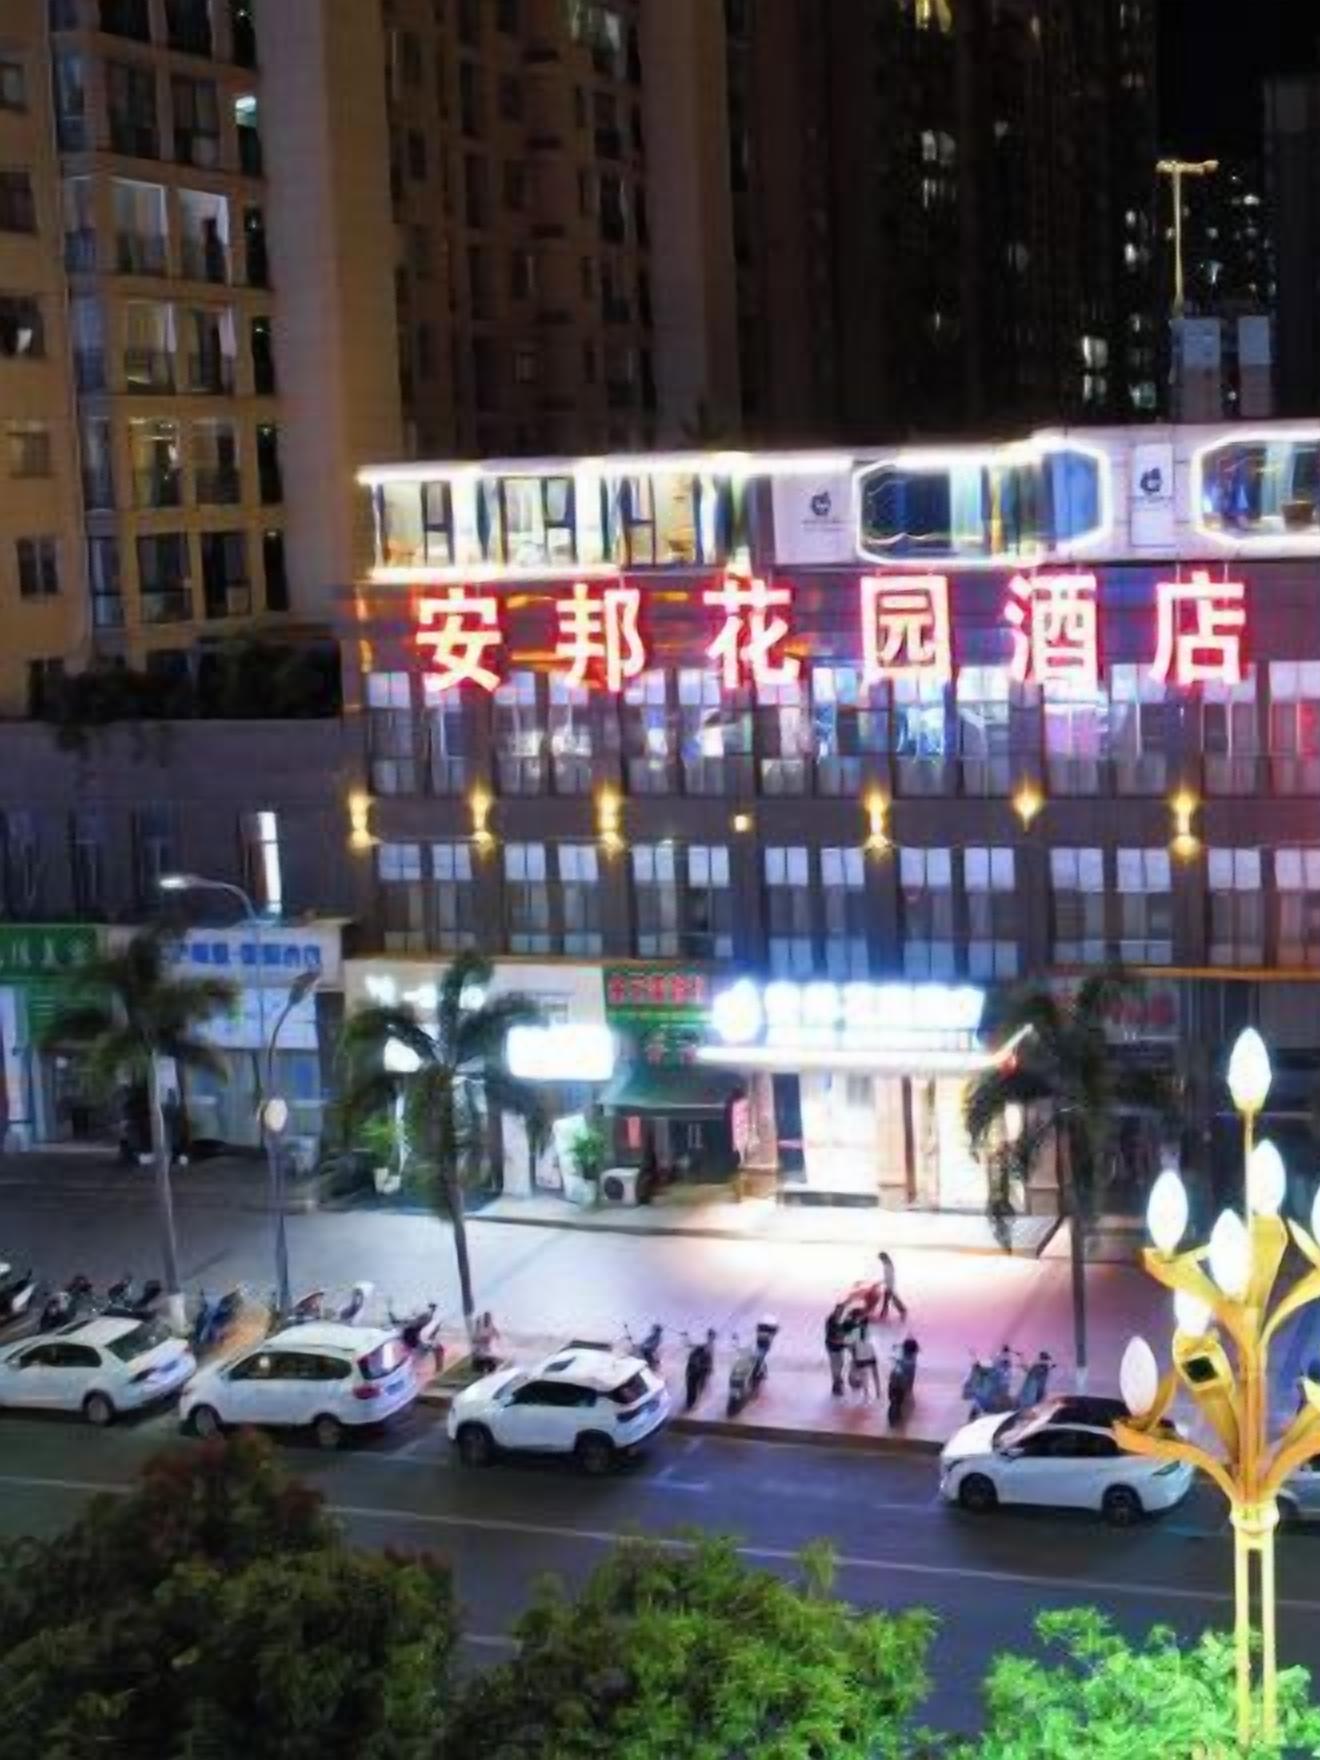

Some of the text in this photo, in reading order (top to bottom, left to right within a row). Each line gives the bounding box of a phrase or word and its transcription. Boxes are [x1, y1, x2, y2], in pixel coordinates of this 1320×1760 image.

[416, 575, 1247, 694] 安邦花园酒店
